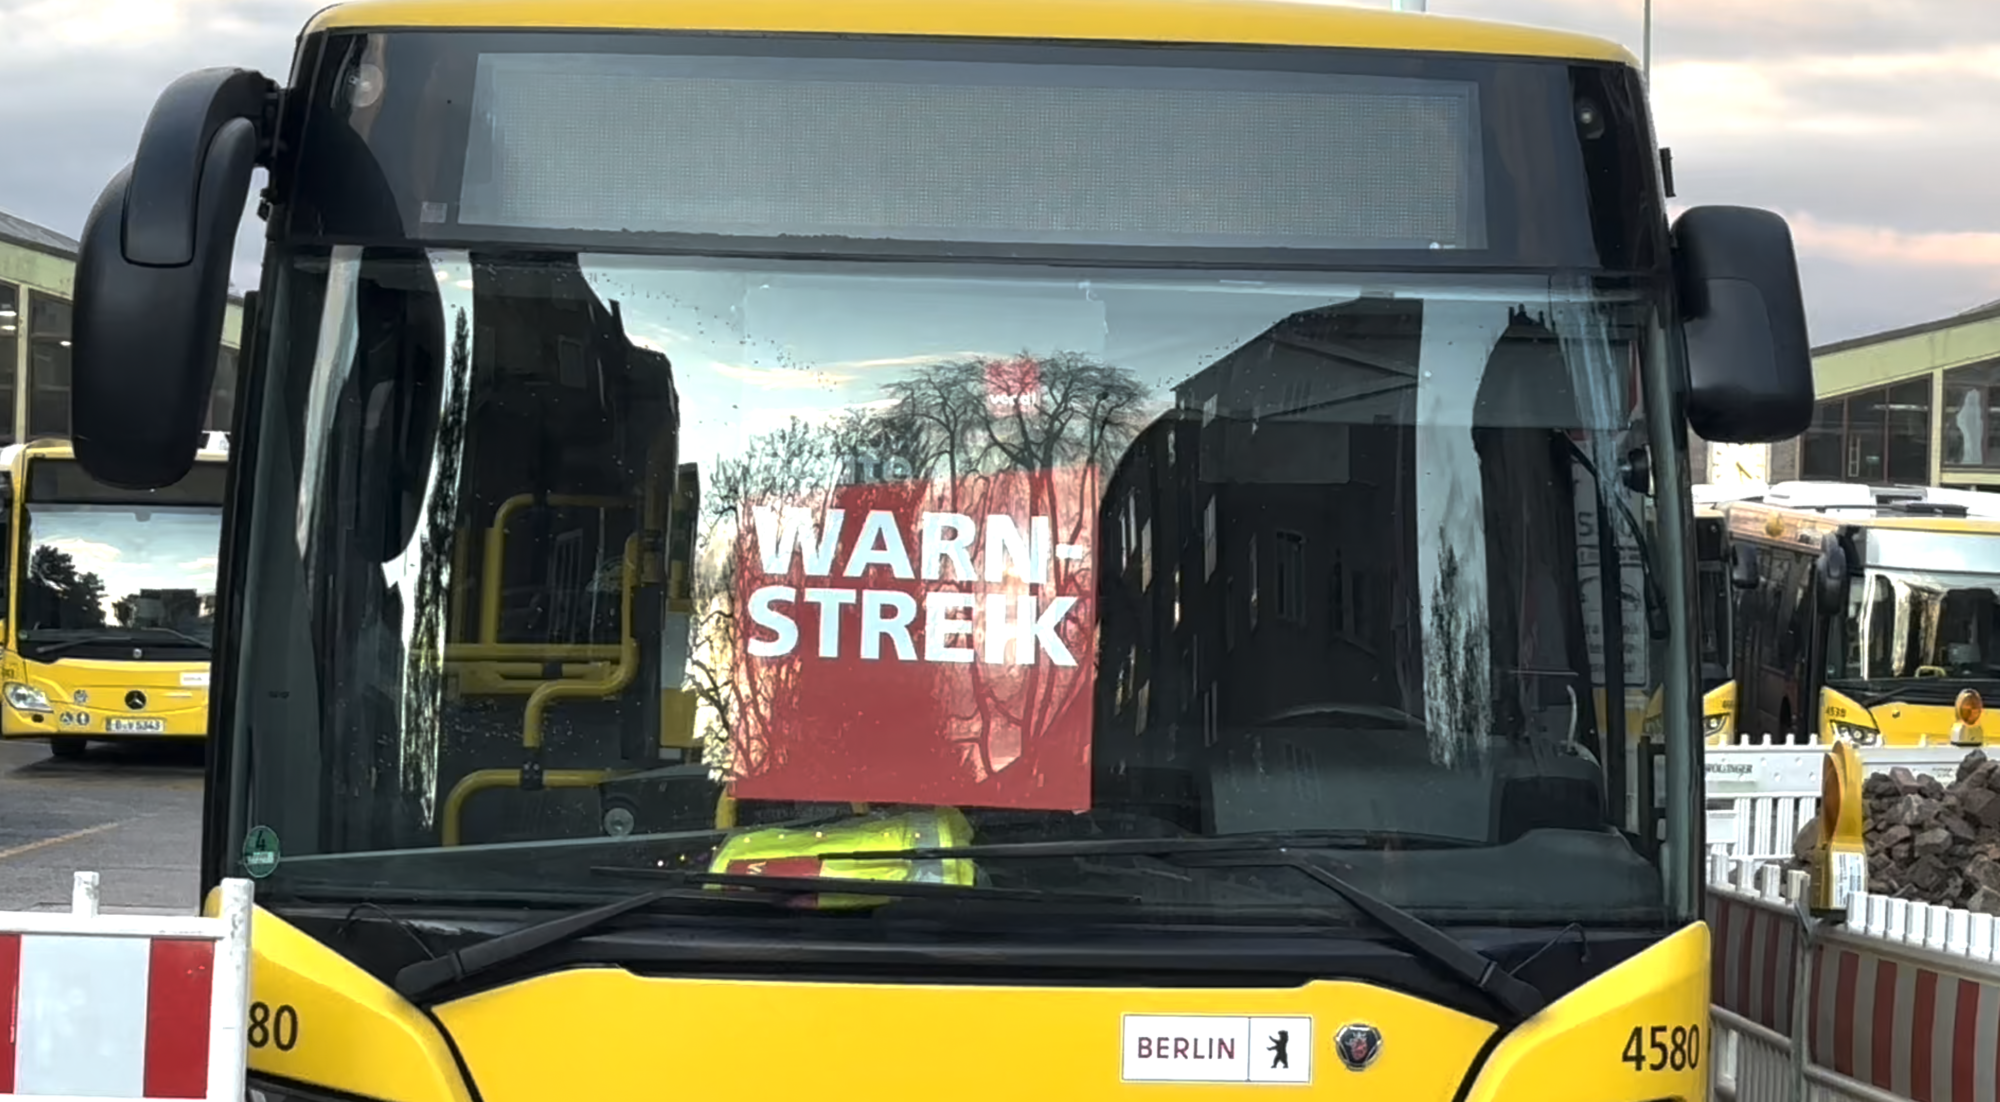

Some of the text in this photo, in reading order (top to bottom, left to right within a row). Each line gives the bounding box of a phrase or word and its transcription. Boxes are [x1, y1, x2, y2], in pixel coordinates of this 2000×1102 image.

[988, 390, 1037, 406] verdi
[751, 504, 1084, 585] WARN-
[747, 585, 1079, 667] STREIK
[255, 830, 266, 852] 4
[247, 1001, 298, 1052] 80
[1137, 1036, 1236, 1060] BERLIN
[1621, 1023, 1700, 1072] 4580
